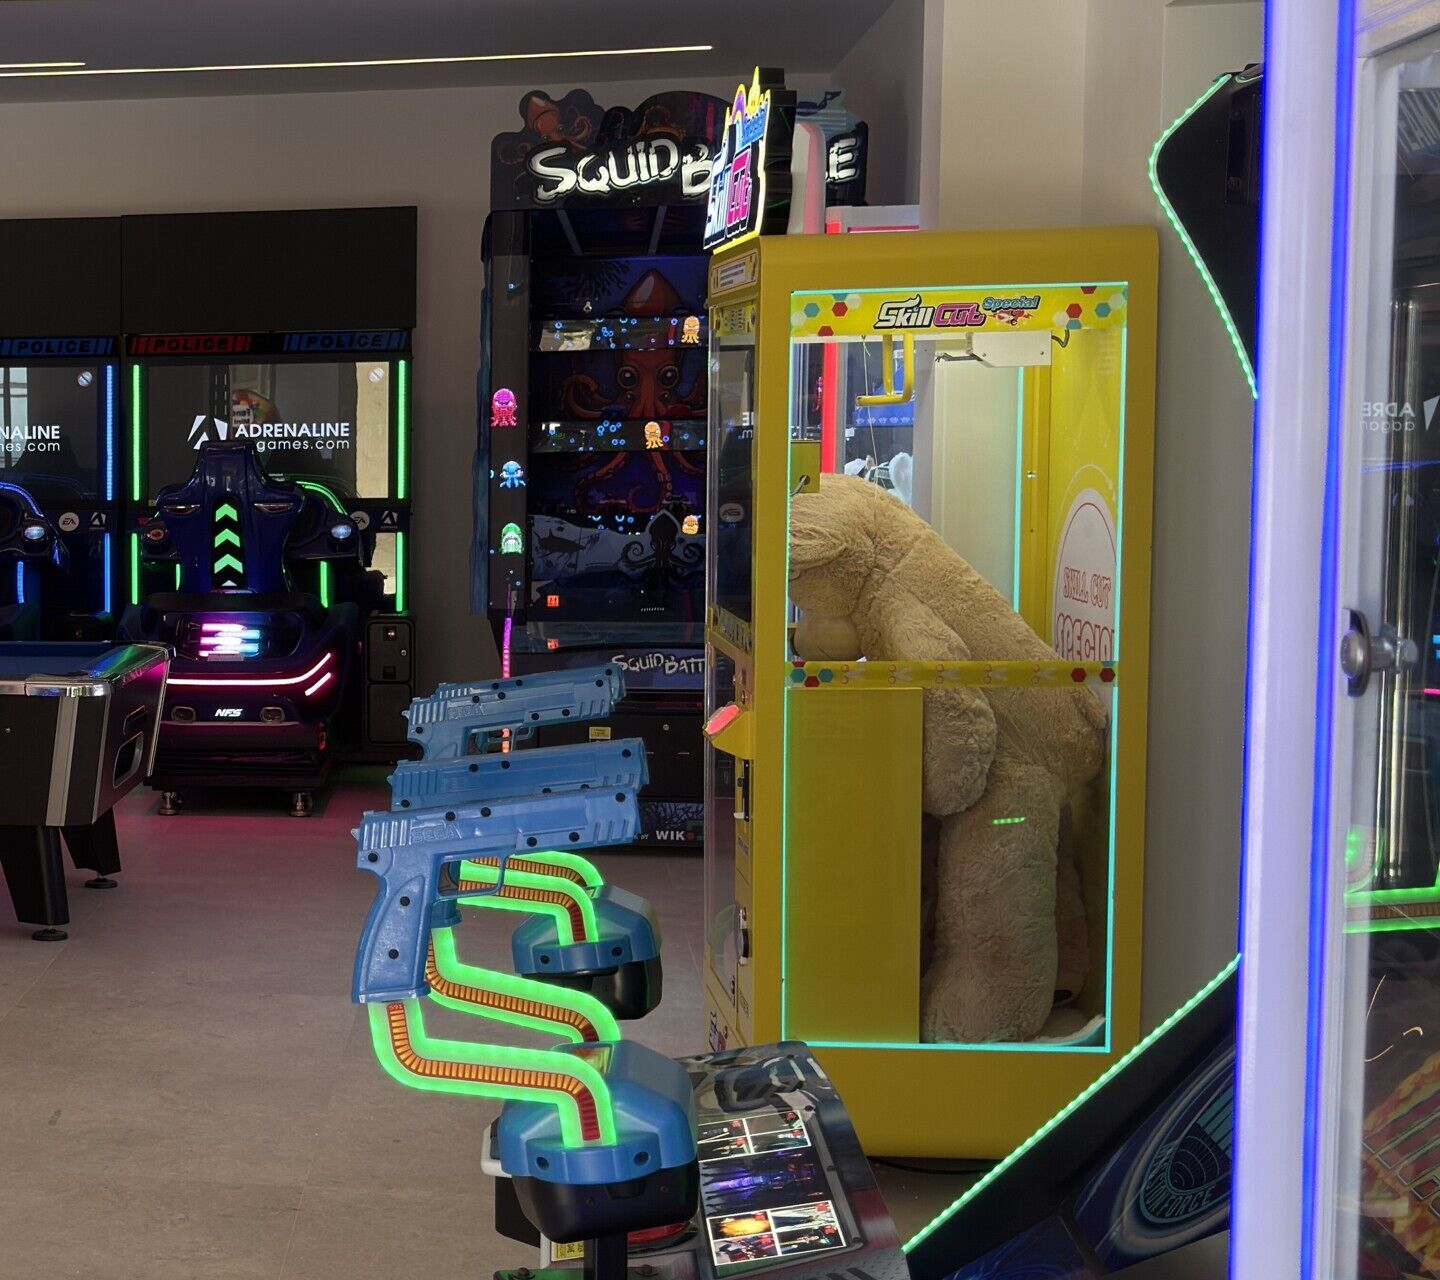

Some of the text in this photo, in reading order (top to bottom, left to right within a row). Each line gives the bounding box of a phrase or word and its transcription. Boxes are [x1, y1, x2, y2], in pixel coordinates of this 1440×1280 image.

[529, 138, 680, 202] SQUID
[873, 293, 1041, 329] Skill Cut Special
[17, 339, 91, 354] POLICE
[152, 337, 230, 352] POLICE
[307, 335, 383, 349] POLICE
[235, 423, 349, 437] ADRENALINE
[256, 439, 349, 452] games.com
[1063, 566, 1112, 609] SKILL CUT
[612, 653, 705, 675] SQUID BATT
[214, 708, 243, 717] NFS
